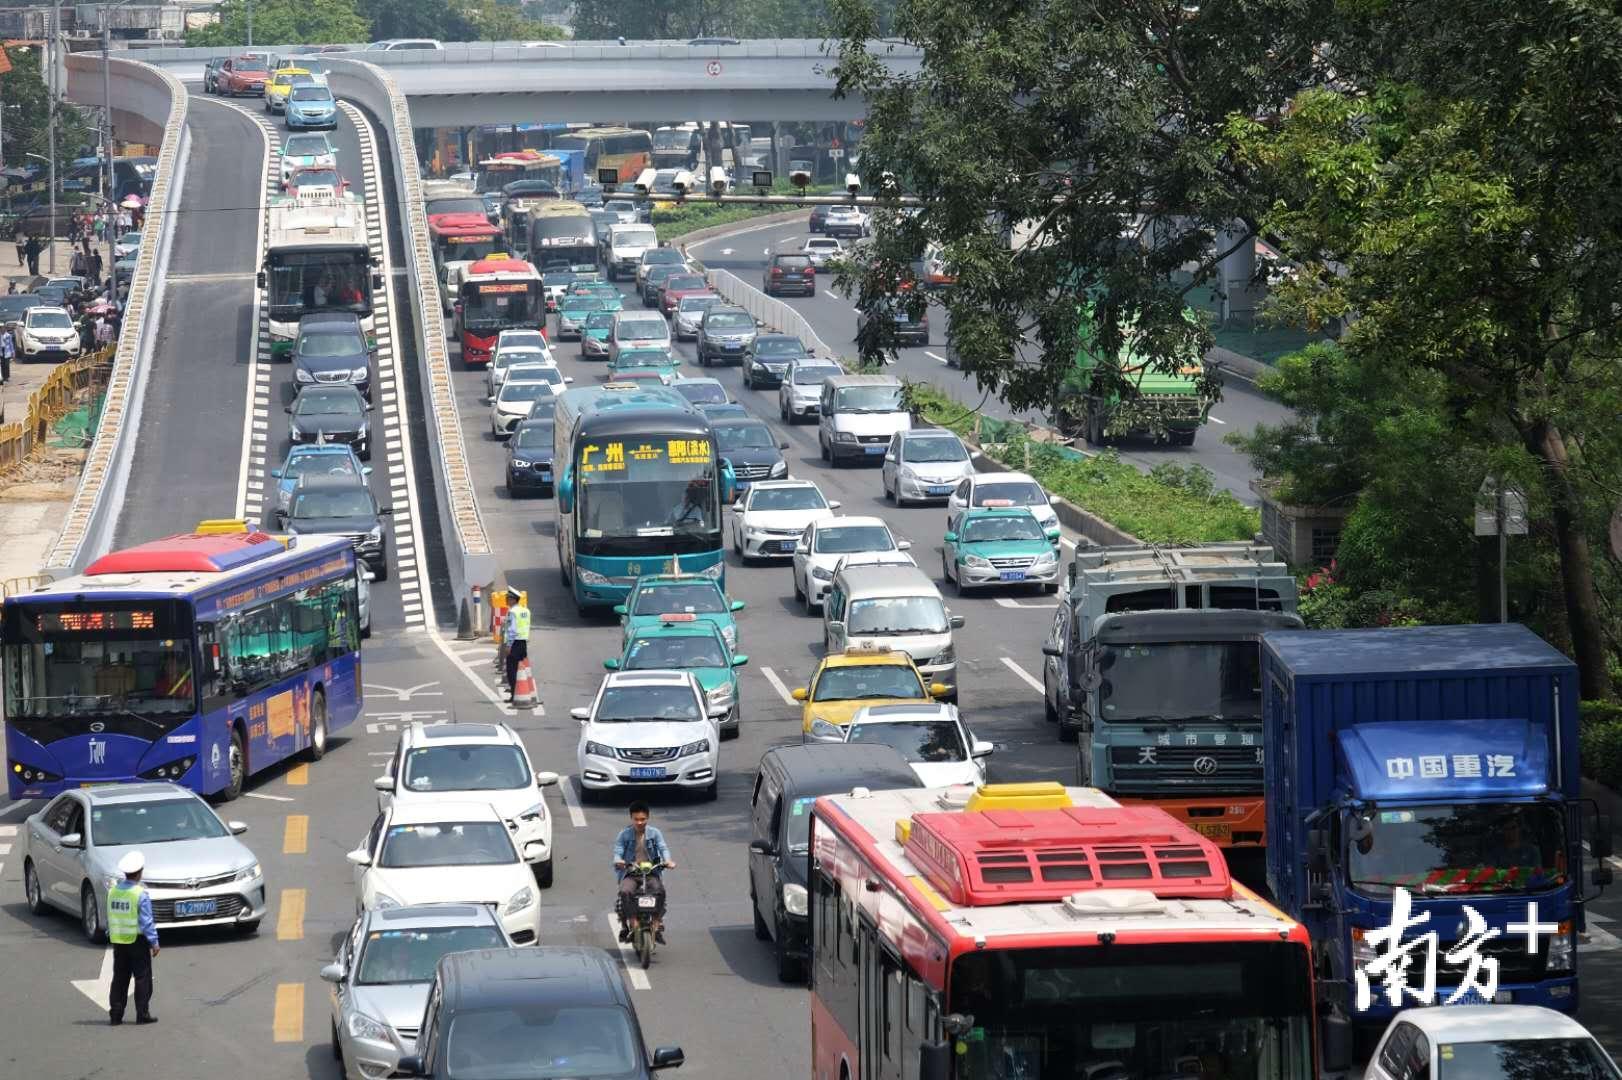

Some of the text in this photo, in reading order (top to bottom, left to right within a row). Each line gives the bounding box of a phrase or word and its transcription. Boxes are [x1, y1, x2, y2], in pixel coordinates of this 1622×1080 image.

[582, 442, 624, 464] 广州
[1157, 733, 1254, 746] 城市管理
[1386, 754, 1516, 779] 中国重汽
